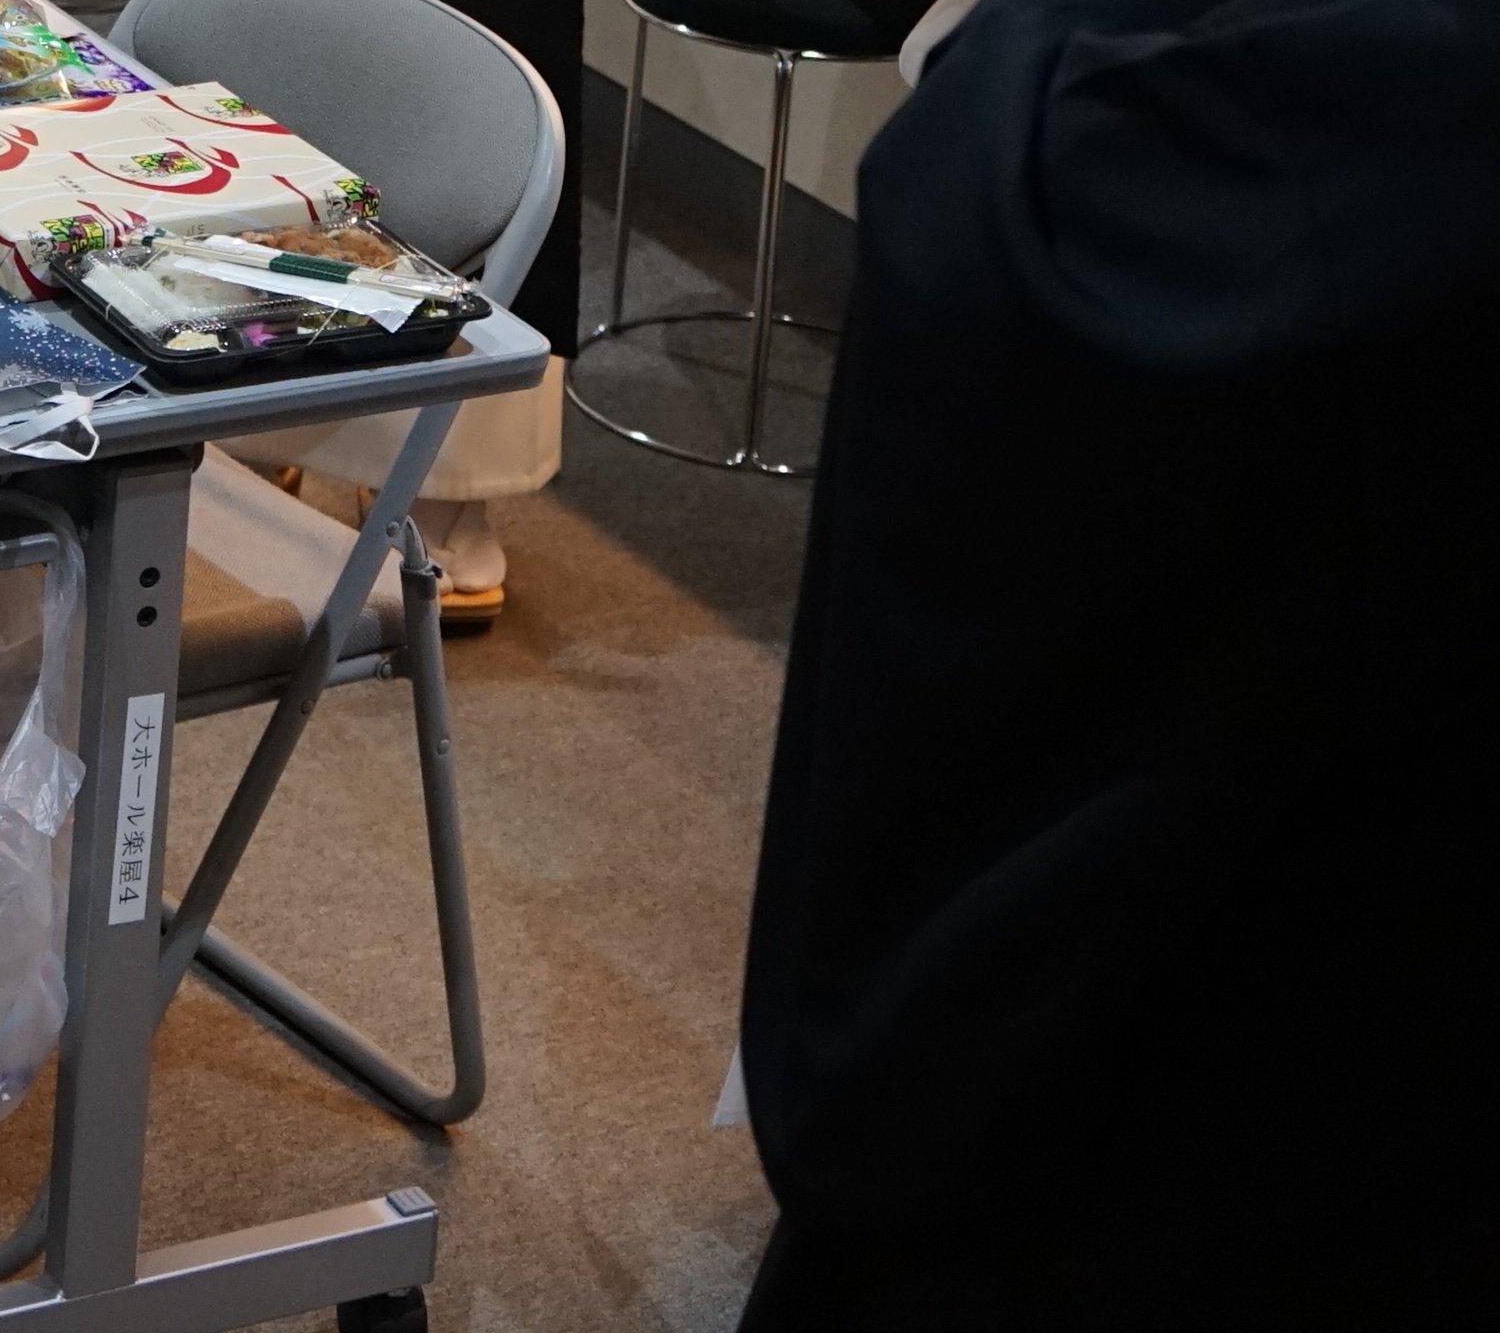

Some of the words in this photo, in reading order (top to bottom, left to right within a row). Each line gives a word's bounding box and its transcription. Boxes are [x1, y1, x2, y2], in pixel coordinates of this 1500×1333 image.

[118, 716, 157, 905] 大ホール楽屋4
